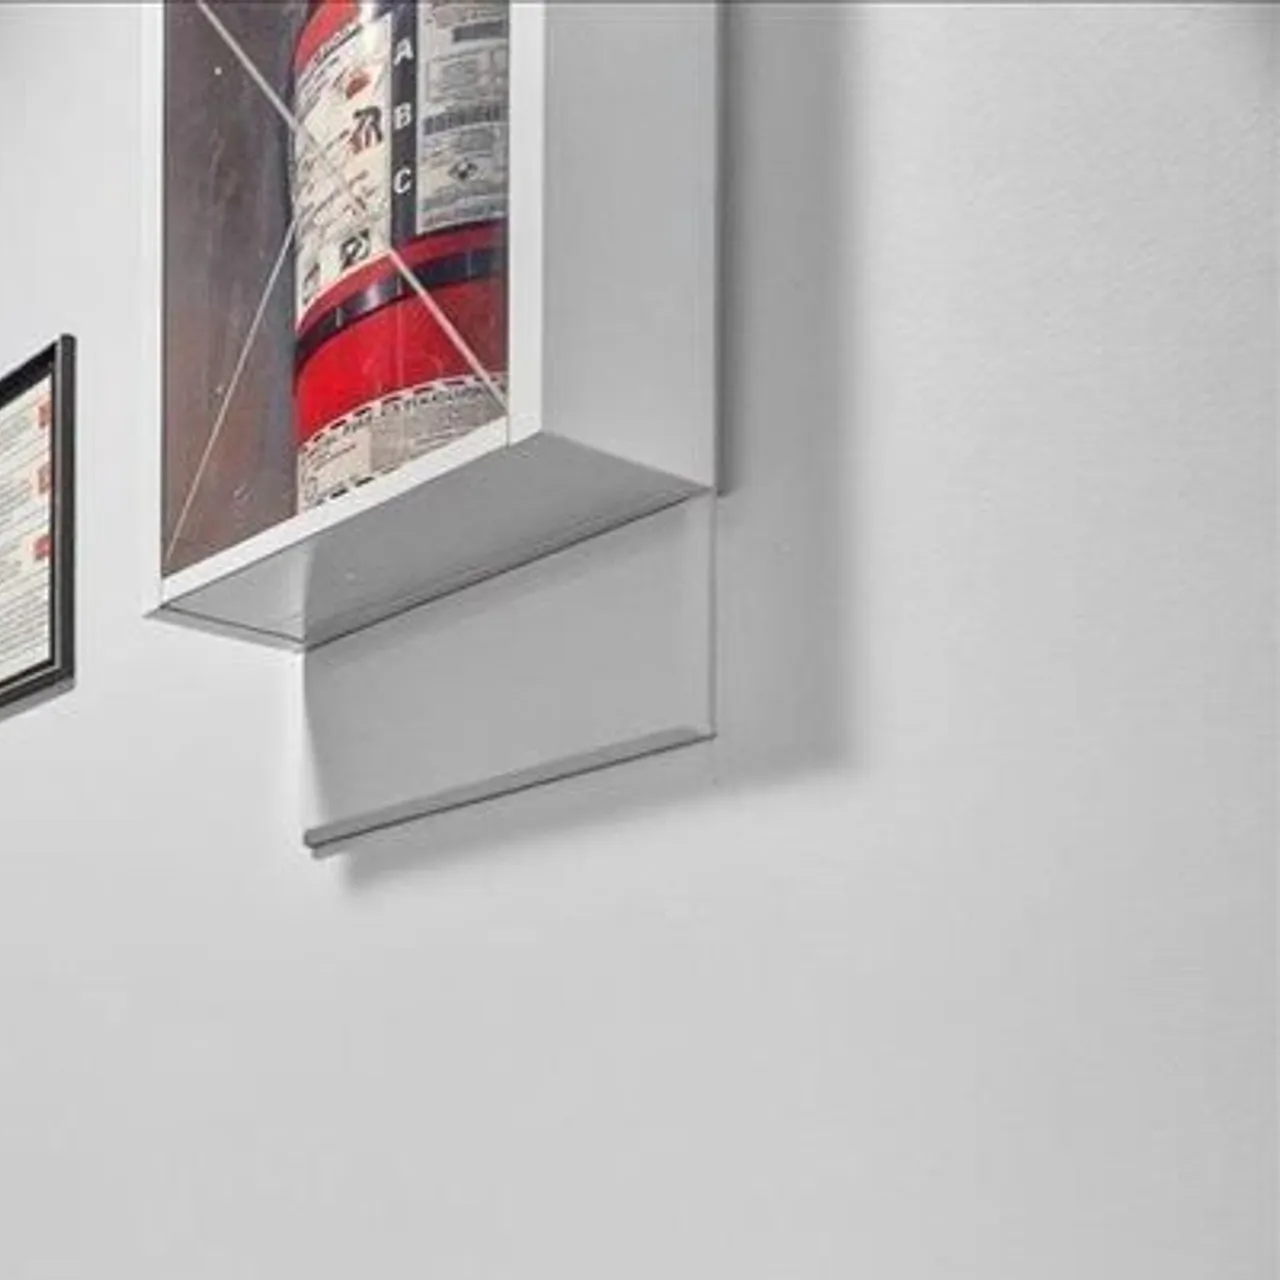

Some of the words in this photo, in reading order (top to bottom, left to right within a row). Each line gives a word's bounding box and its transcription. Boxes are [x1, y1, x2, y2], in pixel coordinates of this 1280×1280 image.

[393, 38, 414, 66] A
[393, 102, 413, 130] B
[393, 167, 412, 194] C
